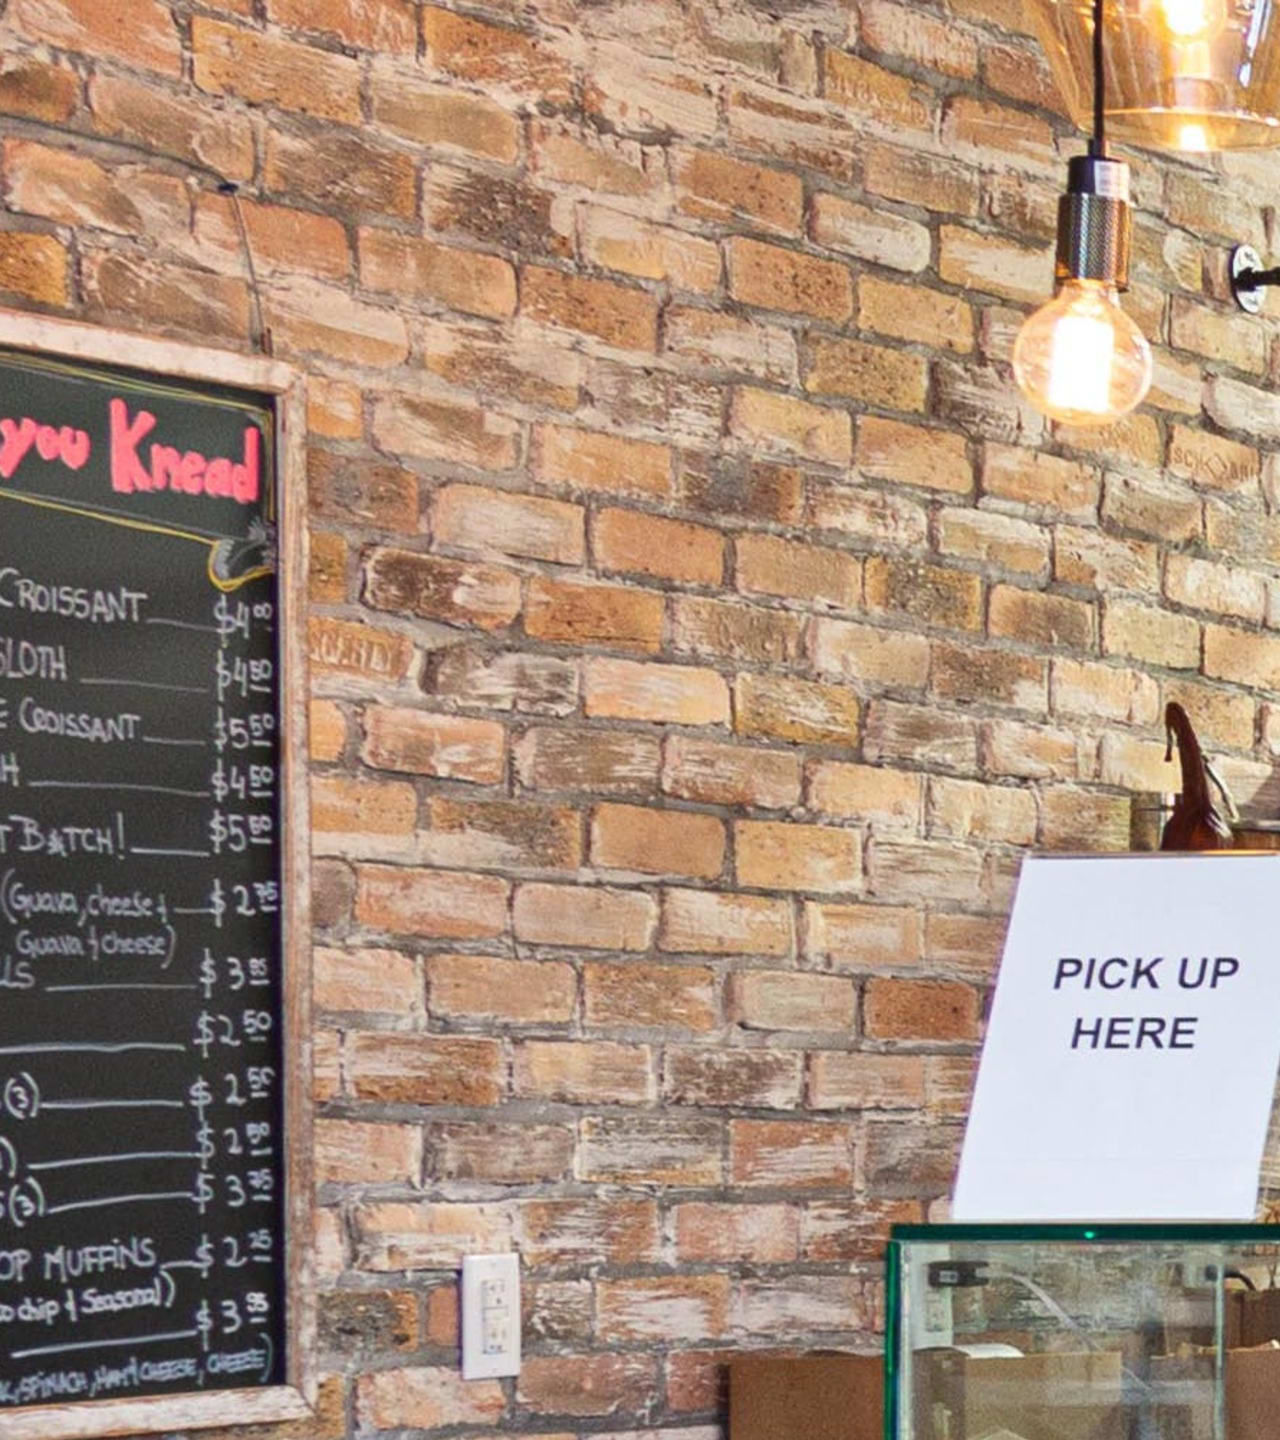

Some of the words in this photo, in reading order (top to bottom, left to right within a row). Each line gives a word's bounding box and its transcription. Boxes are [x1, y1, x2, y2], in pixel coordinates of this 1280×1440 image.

[110, 397, 260, 505] Knead
[1053, 956, 1165, 990] PICK
[1177, 956, 1240, 990] UP
[1070, 1016, 1199, 1050] HERE
